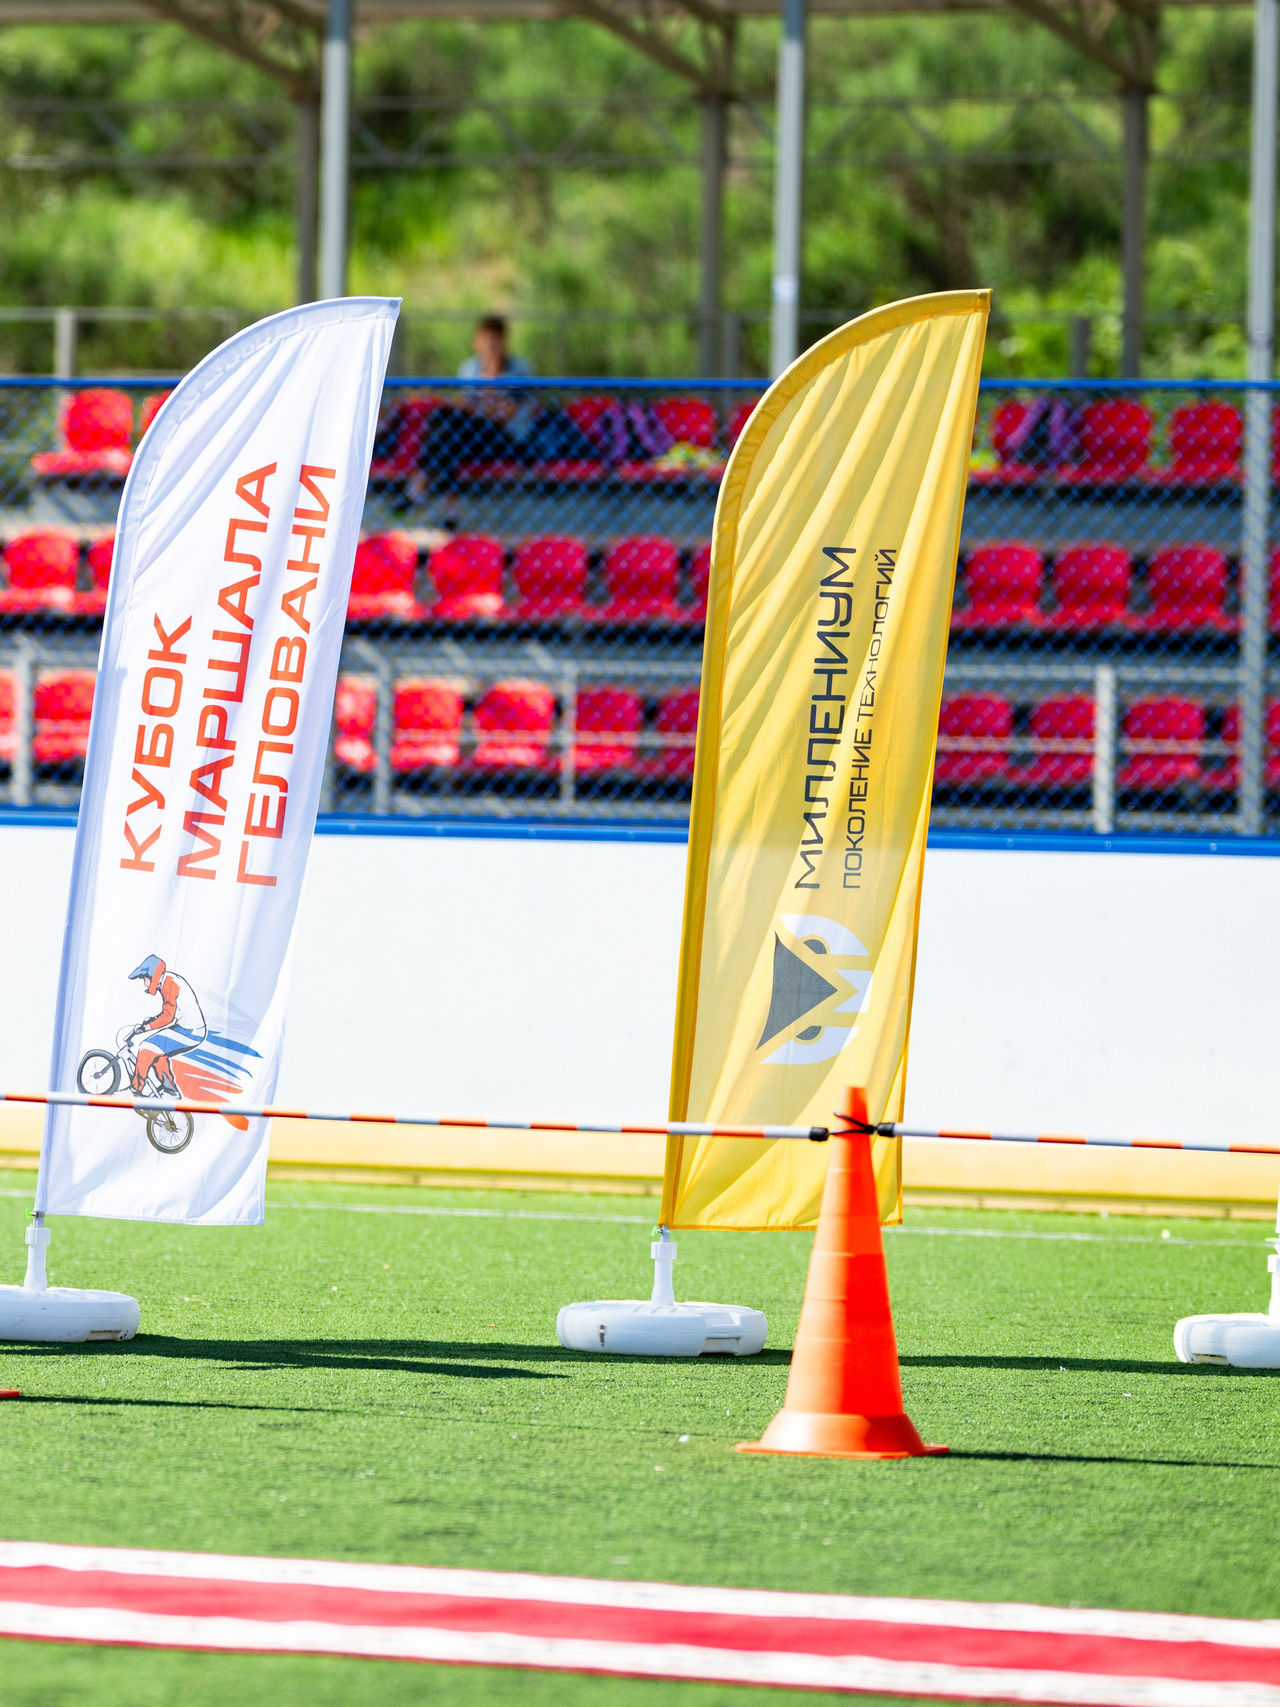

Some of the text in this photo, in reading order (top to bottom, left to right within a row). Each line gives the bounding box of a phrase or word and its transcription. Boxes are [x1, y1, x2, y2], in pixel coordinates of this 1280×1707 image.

[120, 612, 192, 871] КУБОК
[176, 462, 278, 881] МАРШАЛА
[237, 464, 336, 887] ГЕЛОВАНИ
[794, 546, 857, 890] МИЛЛЕНИУМ
[843, 549, 898, 890] ПОКОЛЕНИЕ ТЕХНОЛОГИЙ
